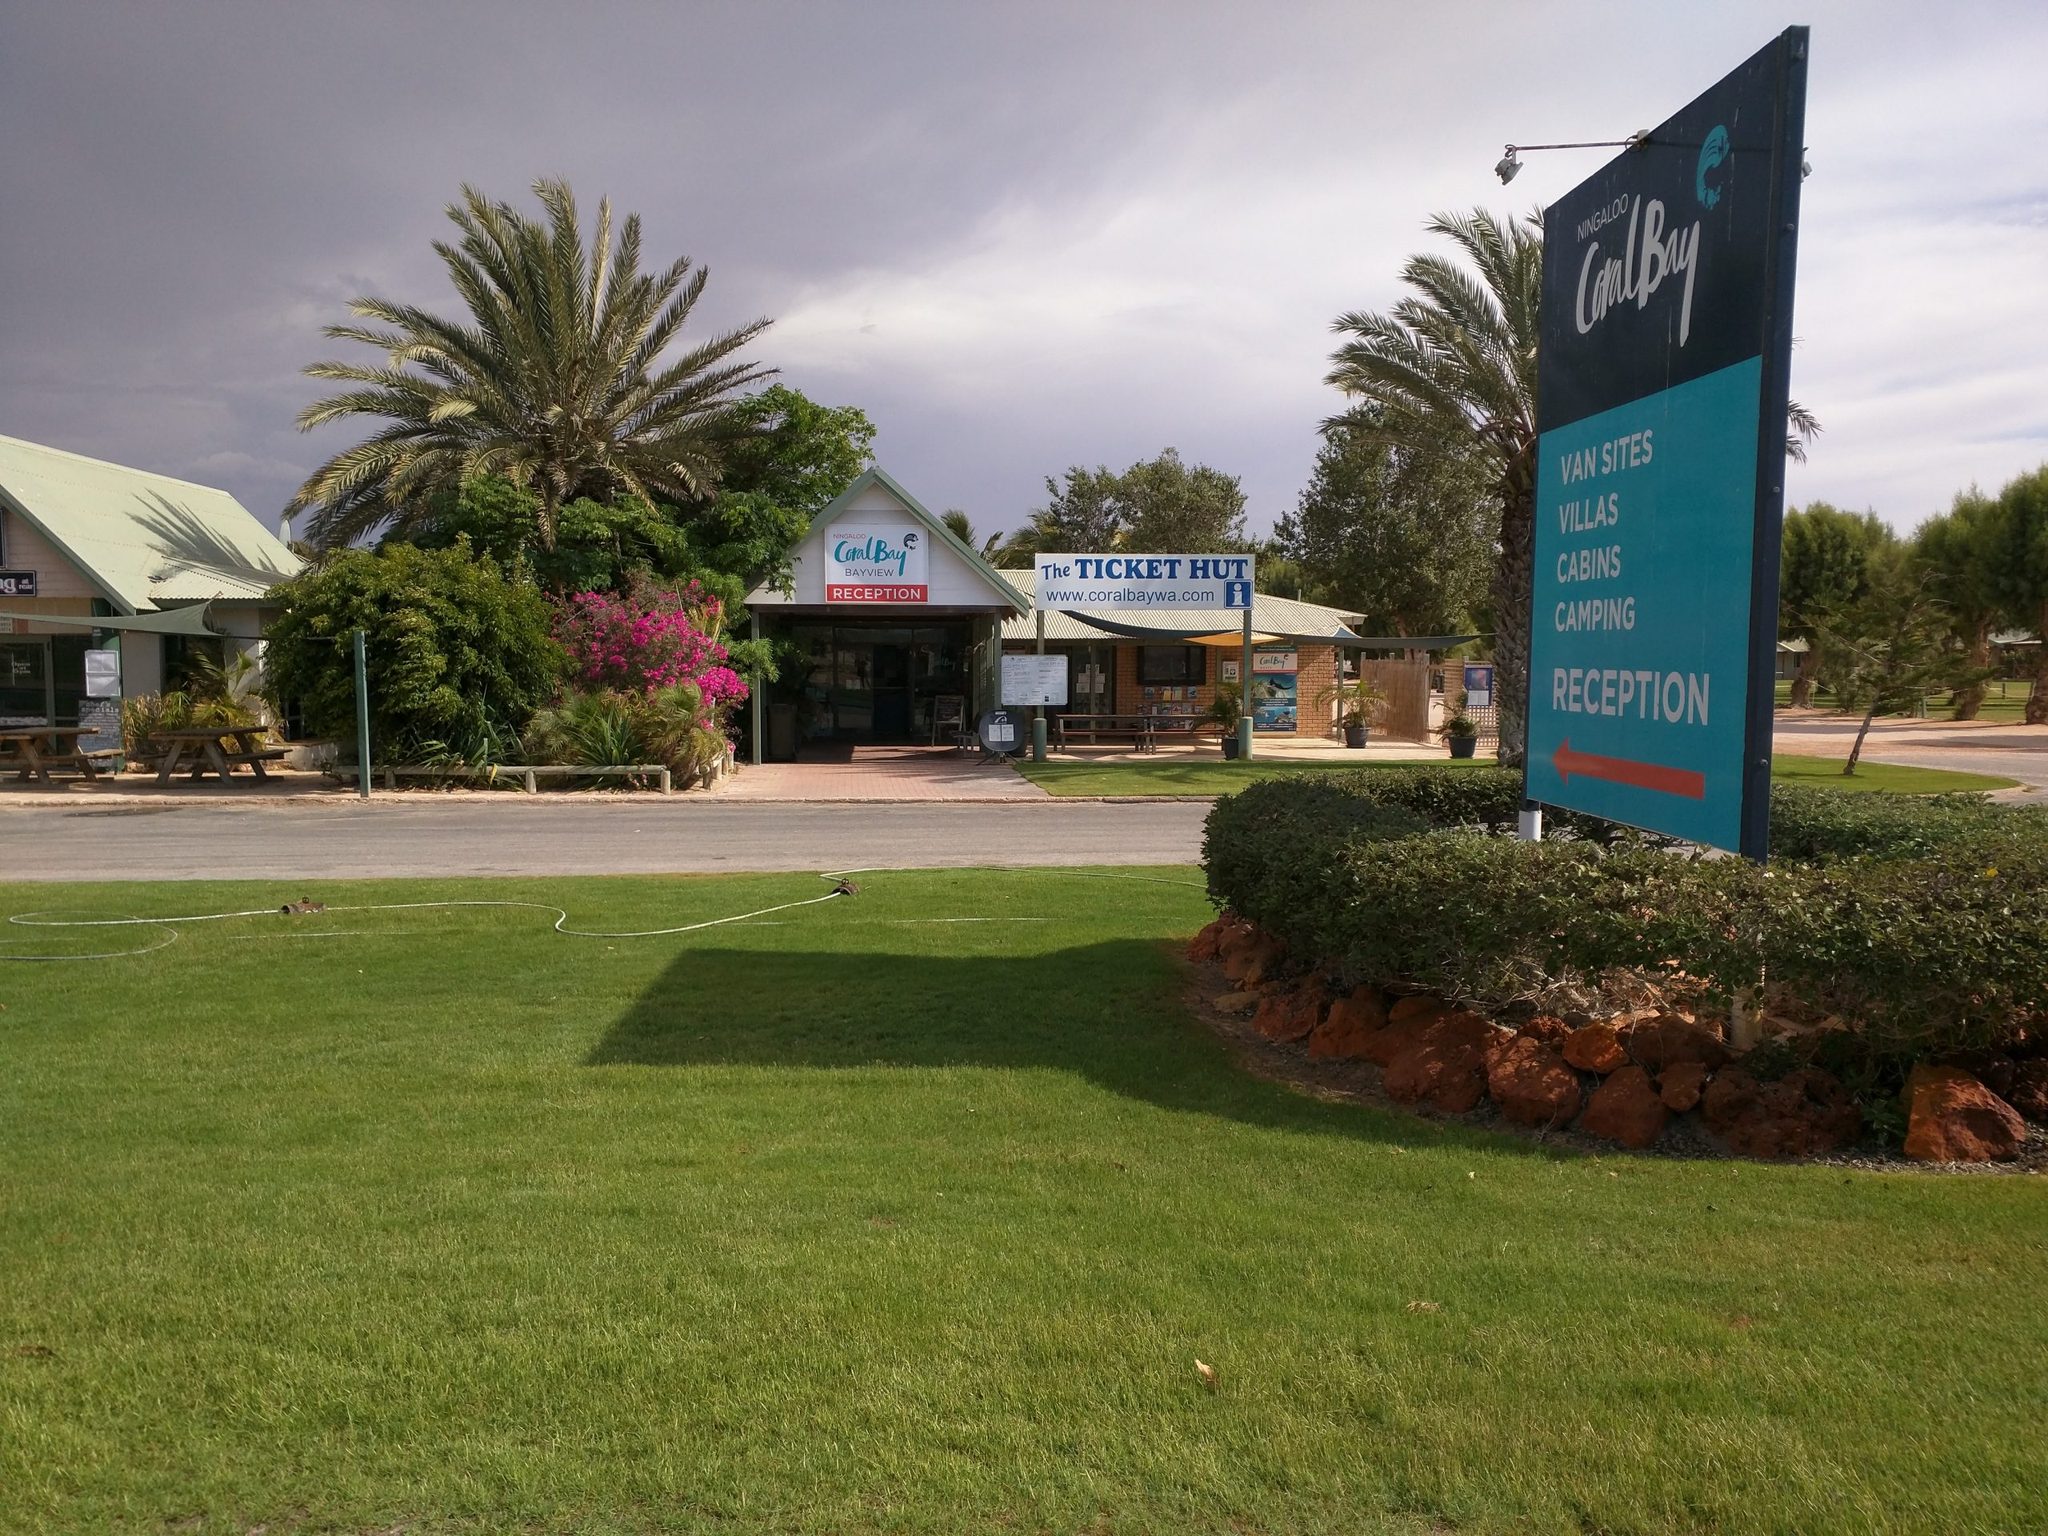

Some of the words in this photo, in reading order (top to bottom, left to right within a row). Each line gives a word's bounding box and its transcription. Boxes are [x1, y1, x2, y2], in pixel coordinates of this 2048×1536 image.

[1577, 193, 1629, 242] NINGALOO
[1561, 446, 1596, 485] VAN
[1601, 429, 1653, 475] SITES
[1559, 492, 1619, 534] VILLAS
[845, 568, 895, 577] BAYVIEW
[1041, 563, 1071, 580] The
[1074, 558, 1182, 580] TICKET
[1189, 558, 1249, 580] HUT
[1557, 544, 1621, 583] CABINS
[833, 588, 920, 599] RECEPTION
[1046, 588, 1215, 605] www.coralbaywa.com
[1555, 596, 1635, 632] CAMPING
[1553, 668, 1710, 726] RECEPTION
